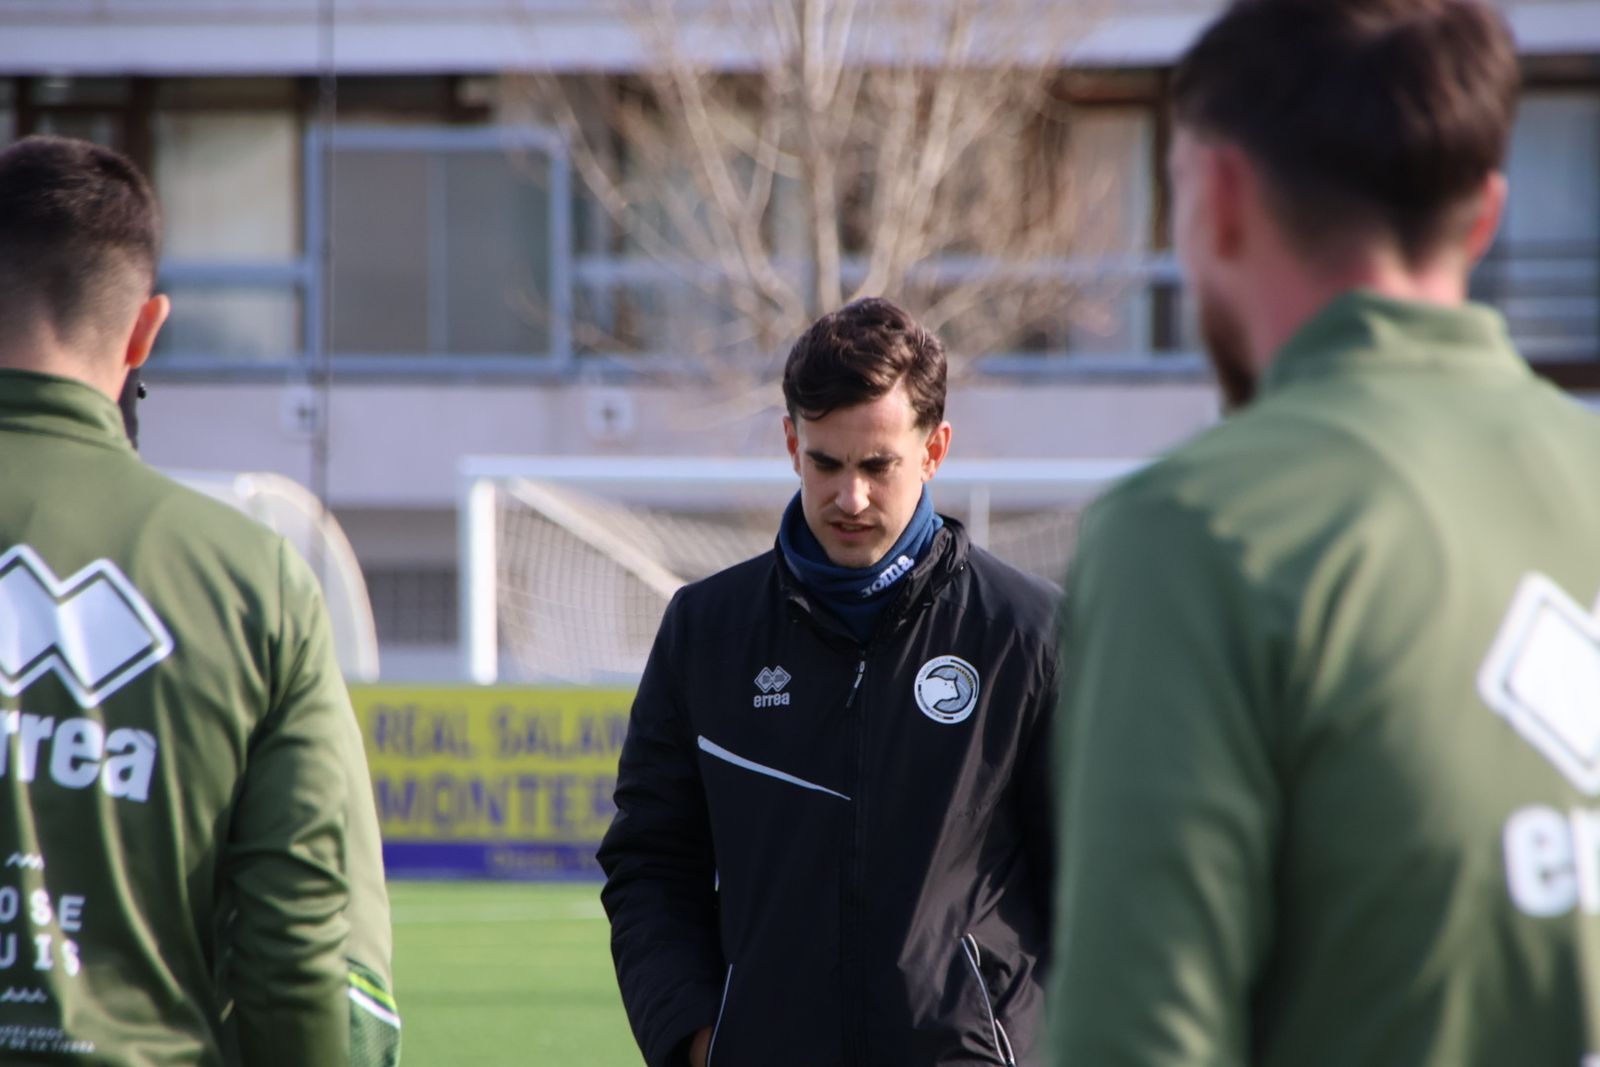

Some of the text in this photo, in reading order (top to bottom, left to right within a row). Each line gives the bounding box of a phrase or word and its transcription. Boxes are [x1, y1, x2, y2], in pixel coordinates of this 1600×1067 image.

[753, 693, 790, 708] errea
[0, 709, 157, 803] rrea
[370, 704, 473, 759] REAL
[1502, 803, 1600, 918] er
[0, 886, 86, 932] OSE
[0, 932, 81, 977] UIS
